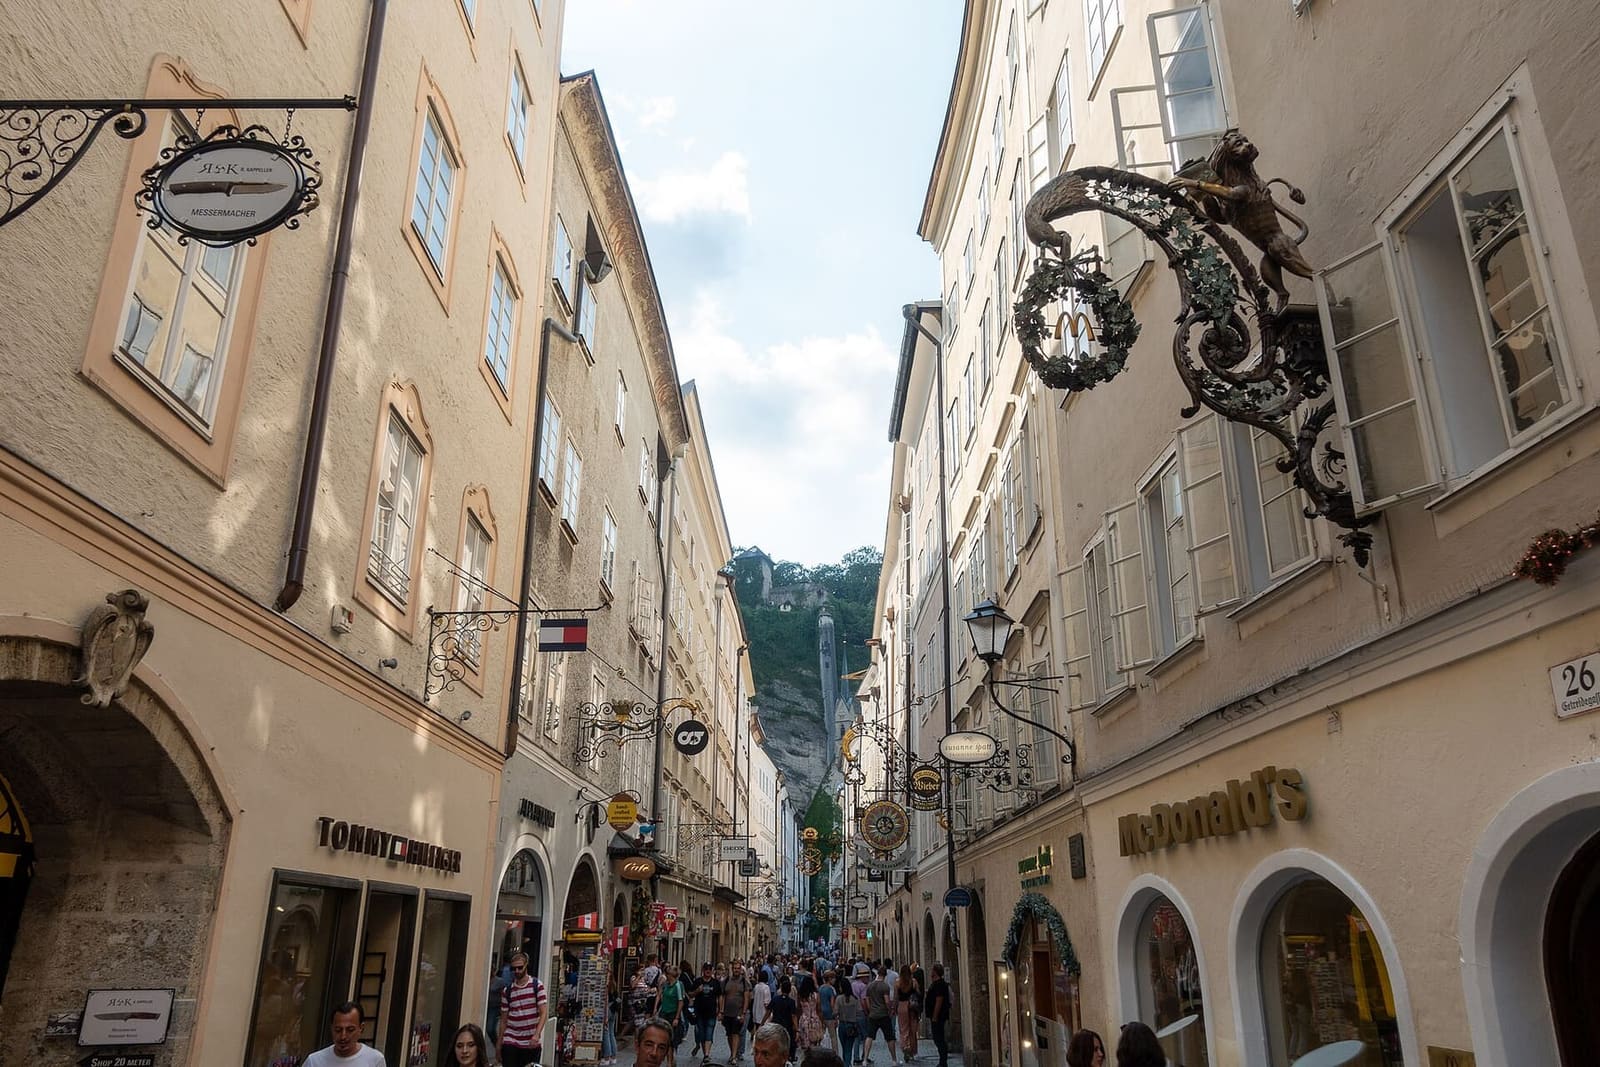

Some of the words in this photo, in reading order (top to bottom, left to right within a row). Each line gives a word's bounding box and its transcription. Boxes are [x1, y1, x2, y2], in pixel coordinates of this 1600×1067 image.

[191, 208, 257, 218] MESSERMACHER
[1562, 660, 1595, 697] 26
[1117, 765, 1308, 857] McDonald's
[318, 815, 394, 859] TOMMY
[406, 839, 462, 874] HILFIGER
[114, 1057, 126, 1067] 20
[126, 1058, 152, 1067] METER
